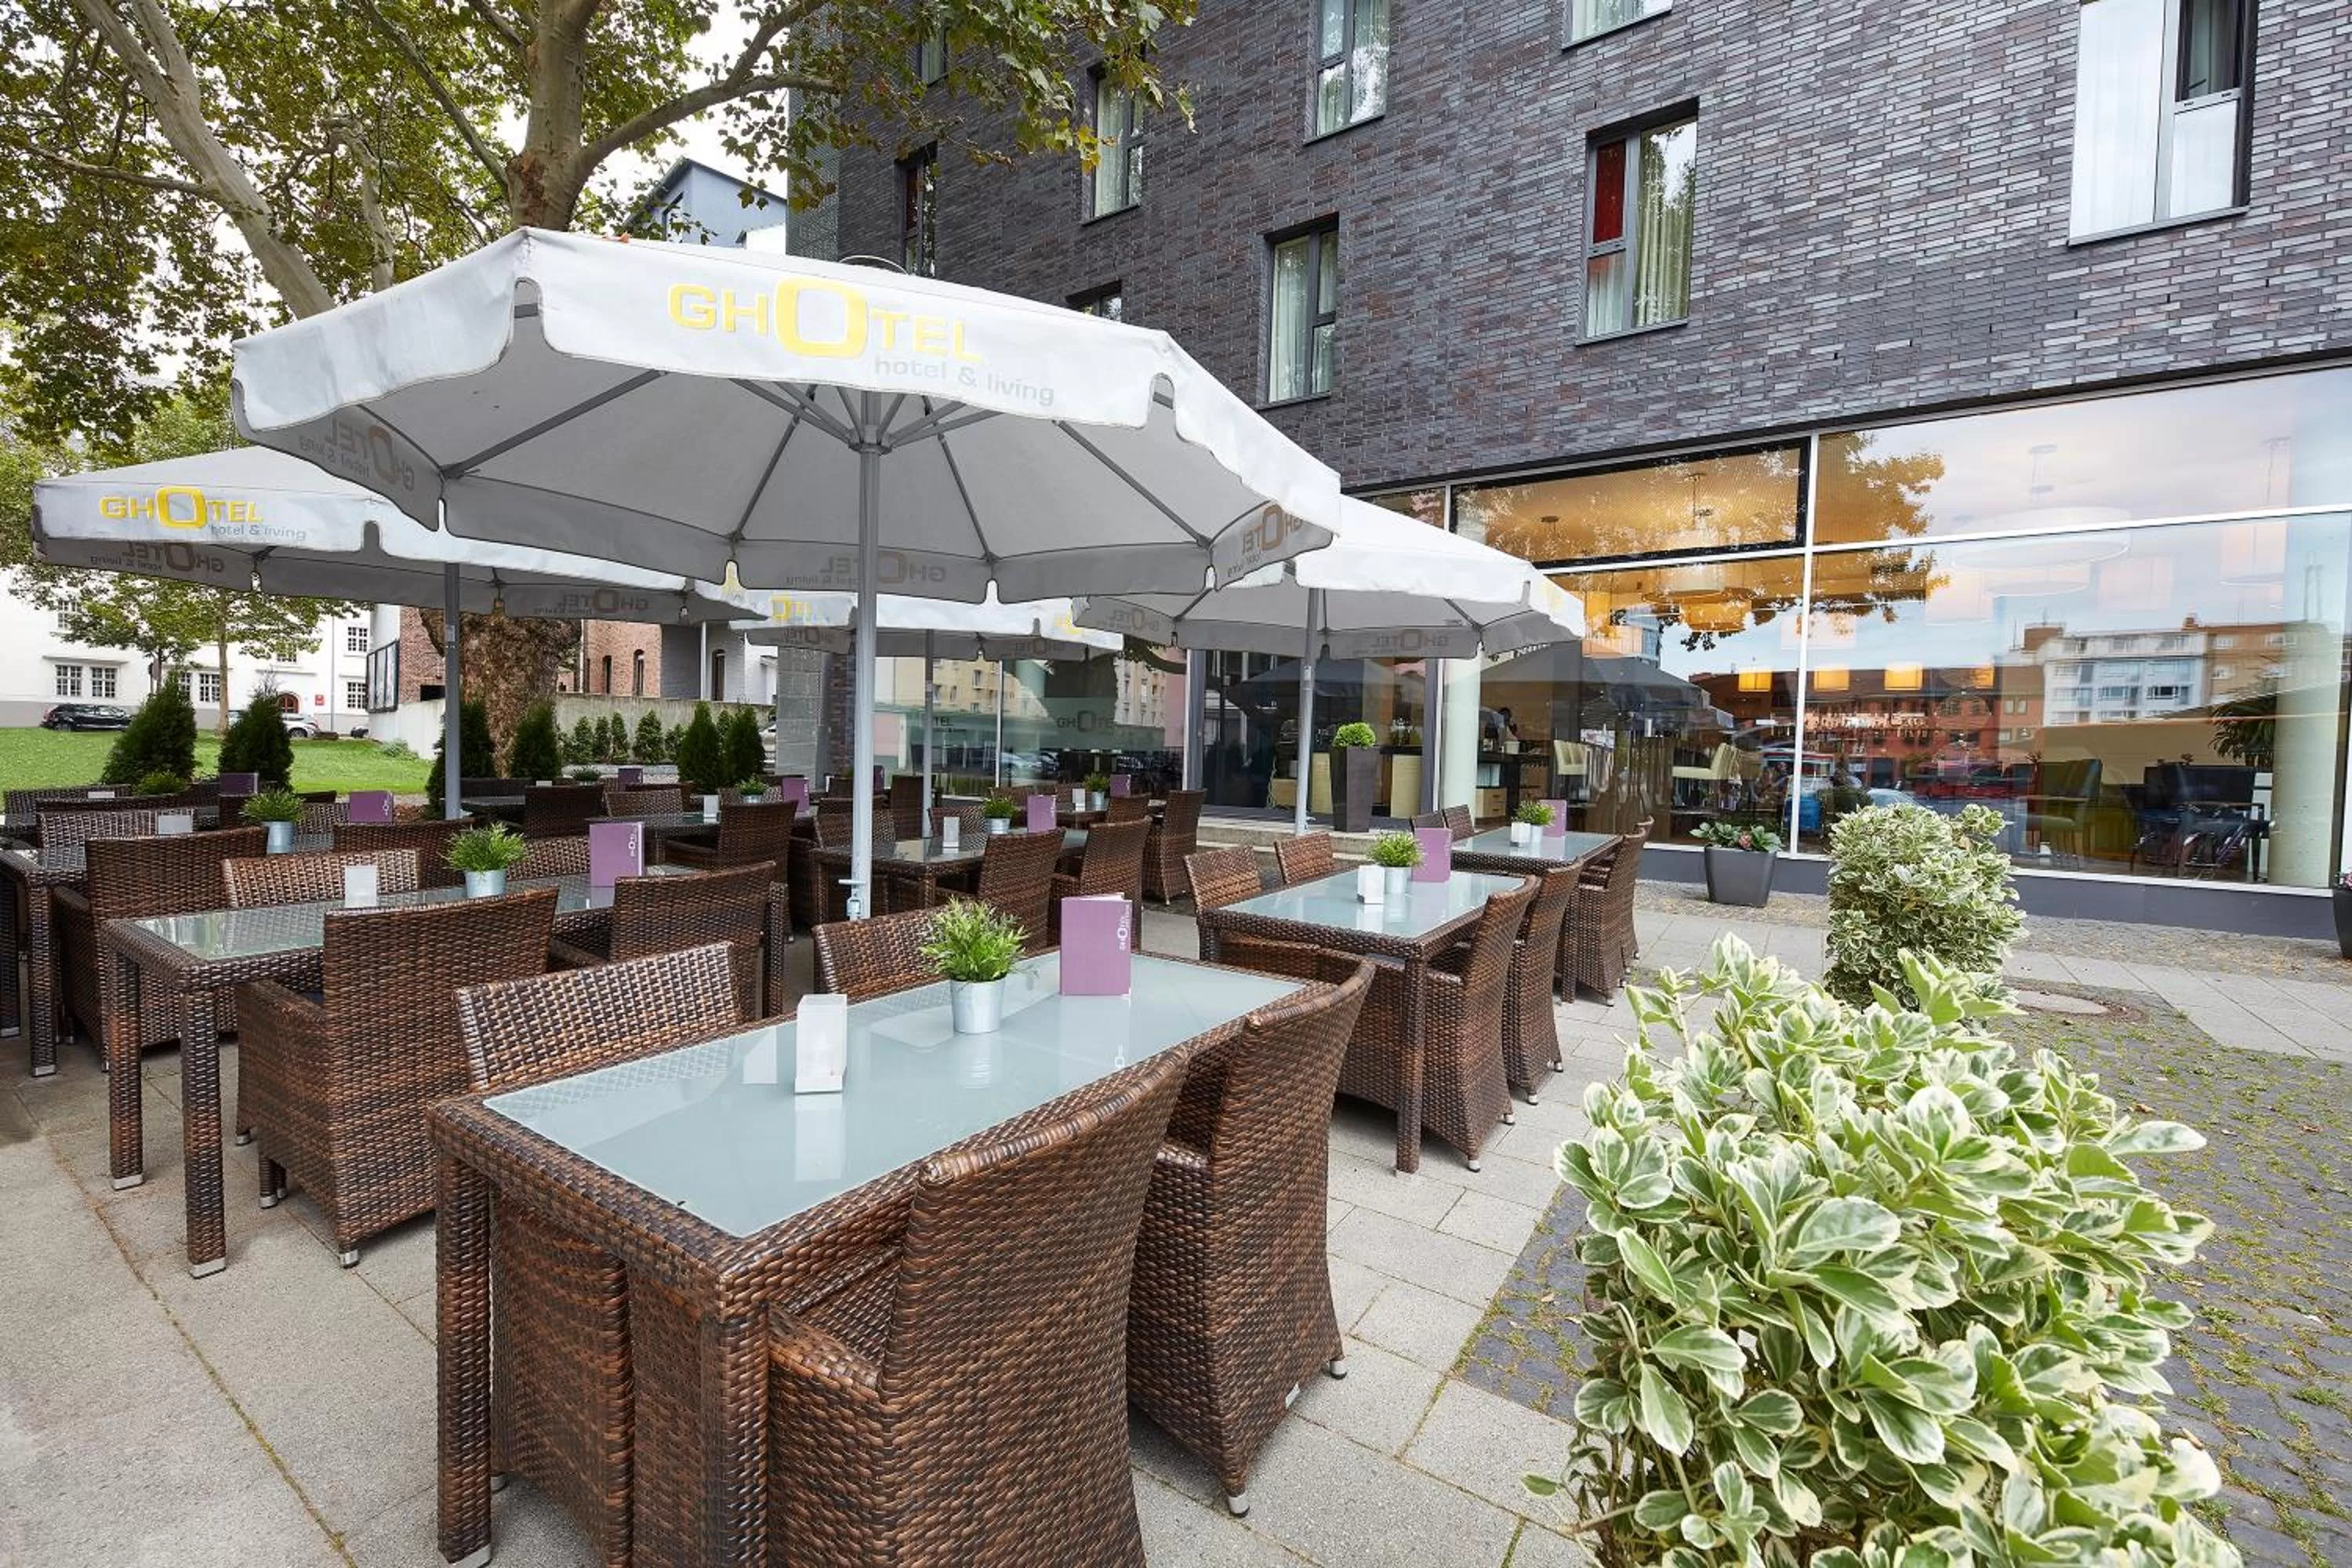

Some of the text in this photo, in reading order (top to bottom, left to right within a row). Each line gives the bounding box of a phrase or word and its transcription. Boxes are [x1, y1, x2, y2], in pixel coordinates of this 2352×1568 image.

[667, 277, 983, 363] GHOTEL
[874, 355, 1054, 407] hotel & living
[100, 485, 264, 529] GHOTEL
[209, 523, 307, 540] hotel & living
